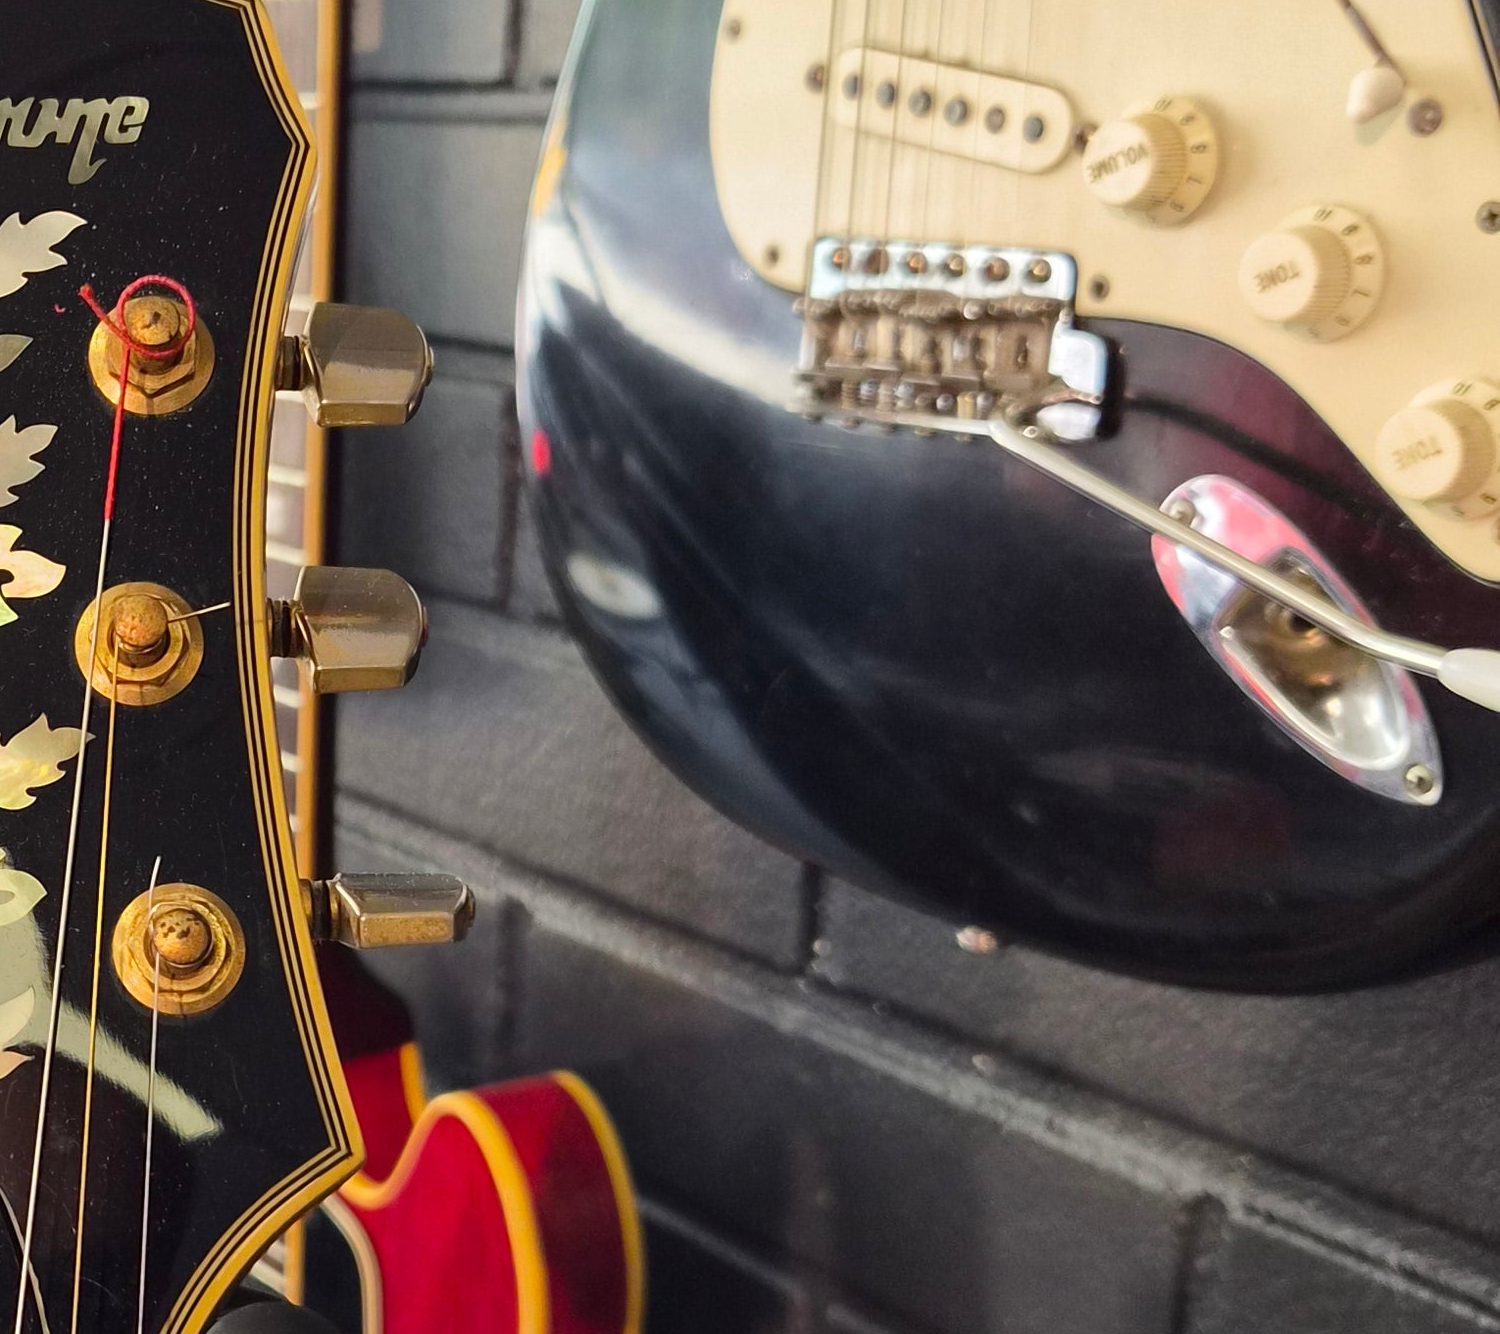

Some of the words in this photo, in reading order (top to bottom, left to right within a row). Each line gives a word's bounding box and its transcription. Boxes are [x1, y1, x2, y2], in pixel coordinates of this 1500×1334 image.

[1086, 143, 1149, 184] VOLUME
[1253, 259, 1301, 295] TONE
[1391, 434, 1443, 472] TONE
